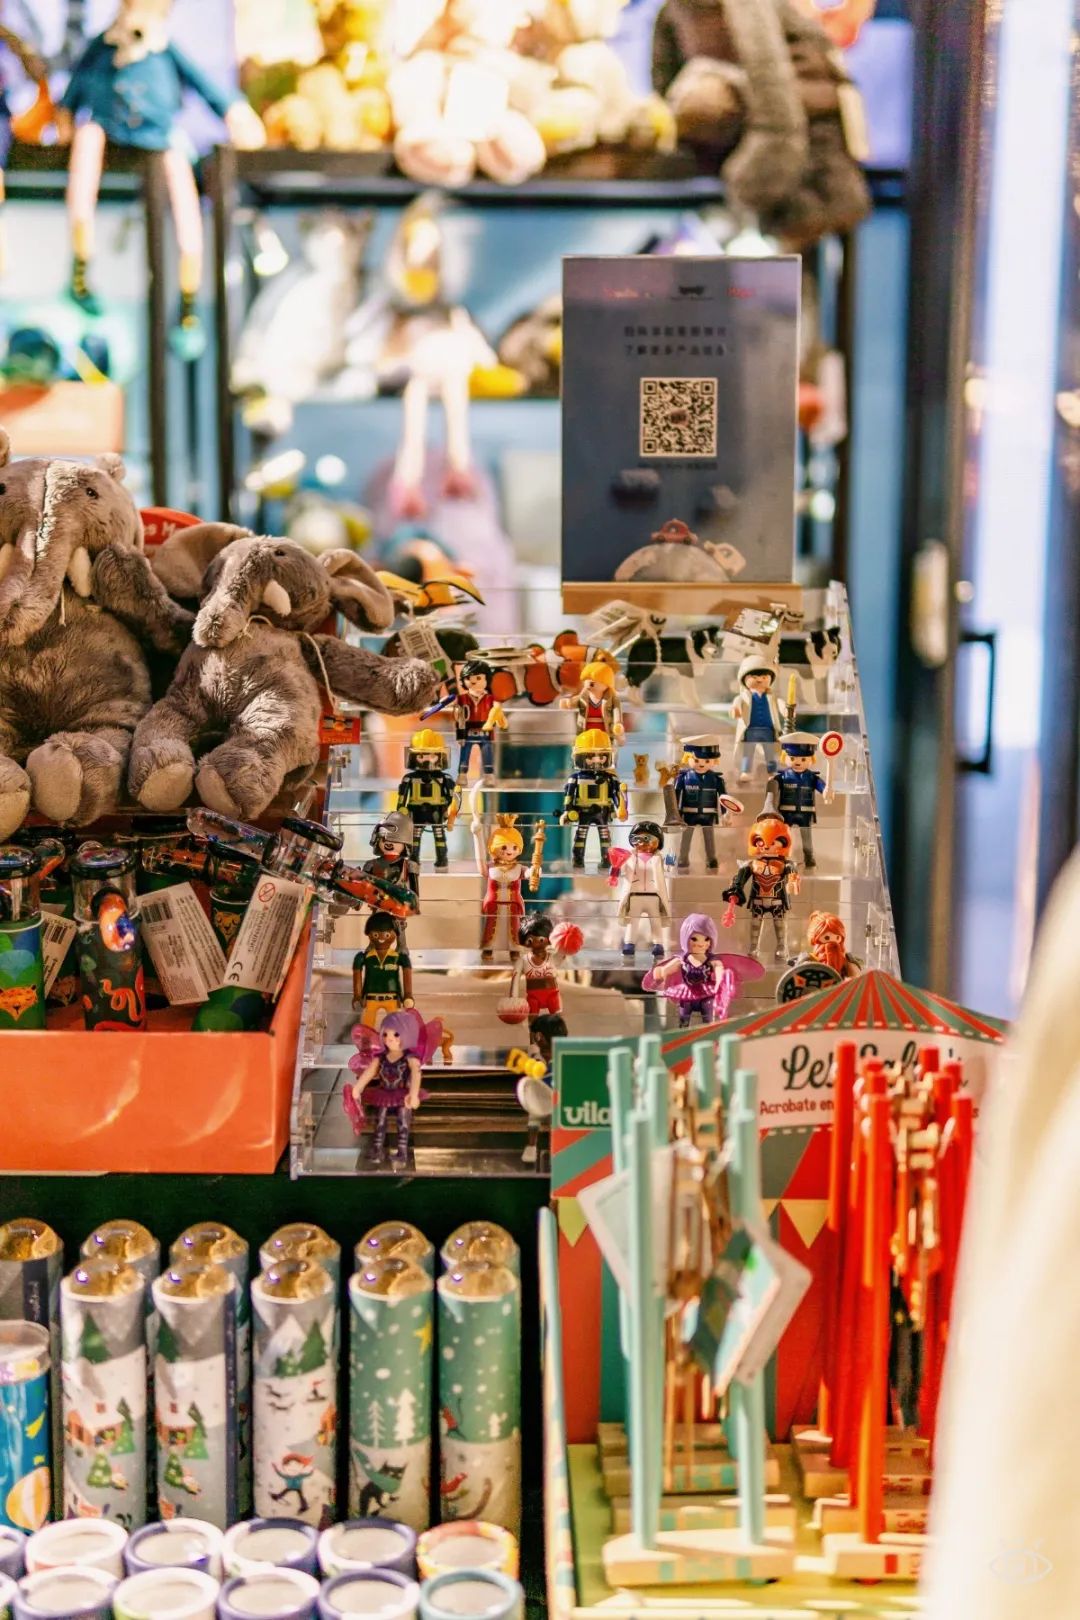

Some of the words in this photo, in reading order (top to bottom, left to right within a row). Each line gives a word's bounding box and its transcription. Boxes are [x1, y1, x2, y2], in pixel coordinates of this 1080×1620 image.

[228, 961, 243, 982] CE
[563, 1100, 611, 1125] vila
[759, 1097, 817, 1115] Acrobate
